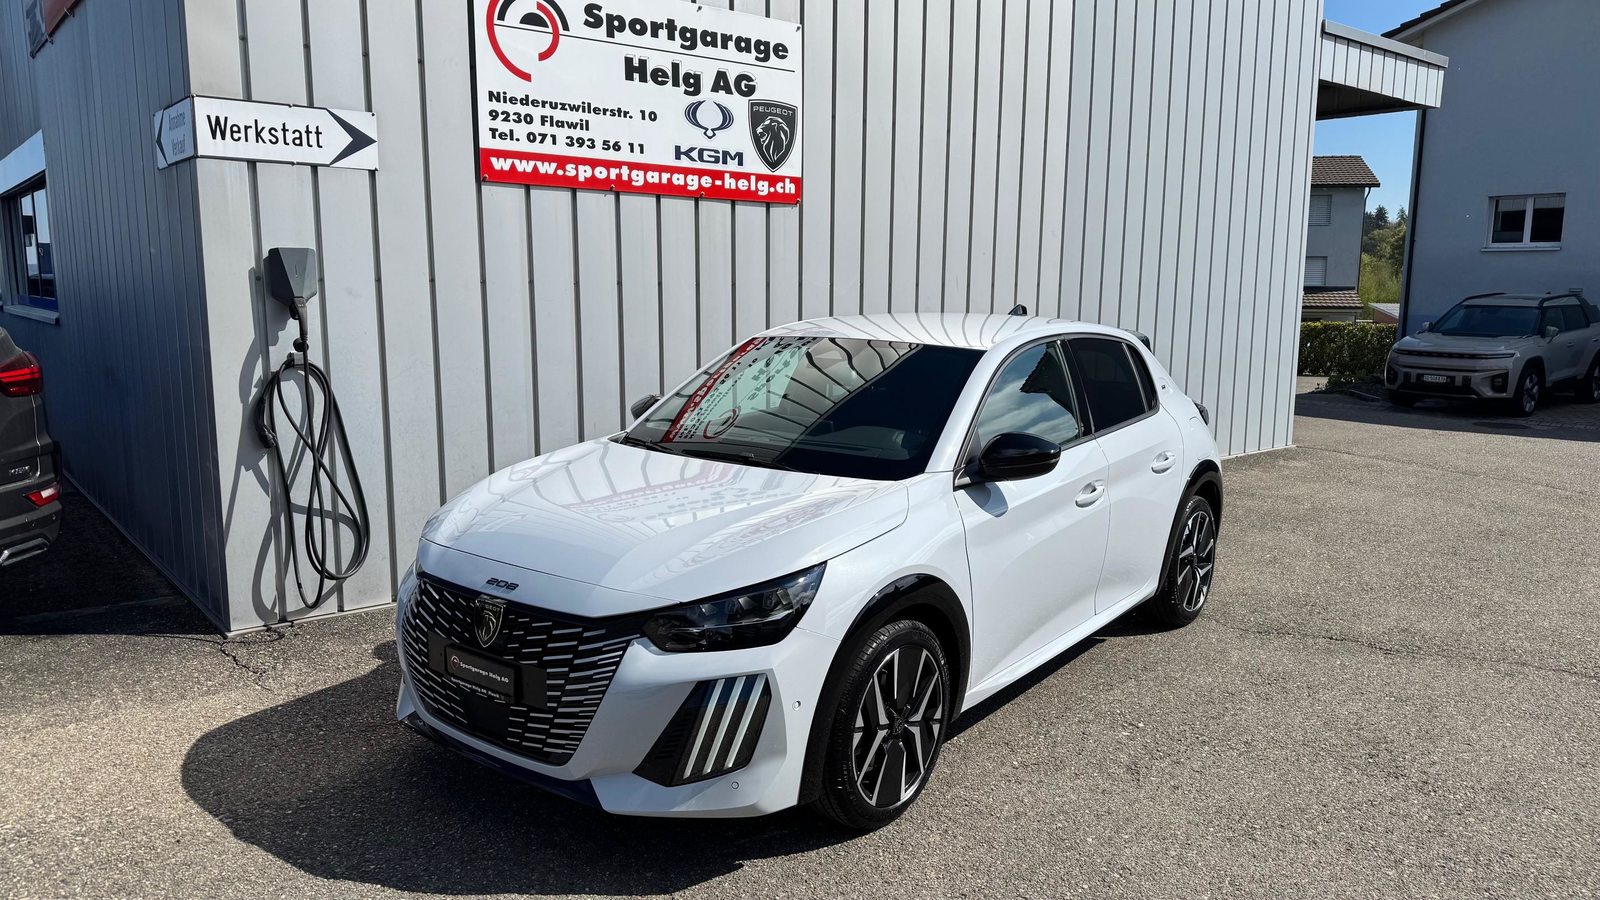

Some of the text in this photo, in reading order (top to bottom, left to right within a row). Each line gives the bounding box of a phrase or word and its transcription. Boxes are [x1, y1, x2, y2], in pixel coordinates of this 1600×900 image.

[583, 2, 789, 63] Sportgarage
[624, 54, 757, 98] Helg AG
[488, 90, 658, 122] Niederuzwilerstr. 10
[752, 105, 793, 117] PEUGEOT
[206, 114, 323, 149] Werkstatt
[488, 109, 590, 132] 9230 Flawil
[489, 128, 645, 155] Tel. 071 393 56 11
[674, 145, 744, 167] KGM
[490, 156, 796, 196] www.sportgarage-helg.ch
[485, 577, 519, 591] 208
[460, 661, 489, 676] Sportgarage
